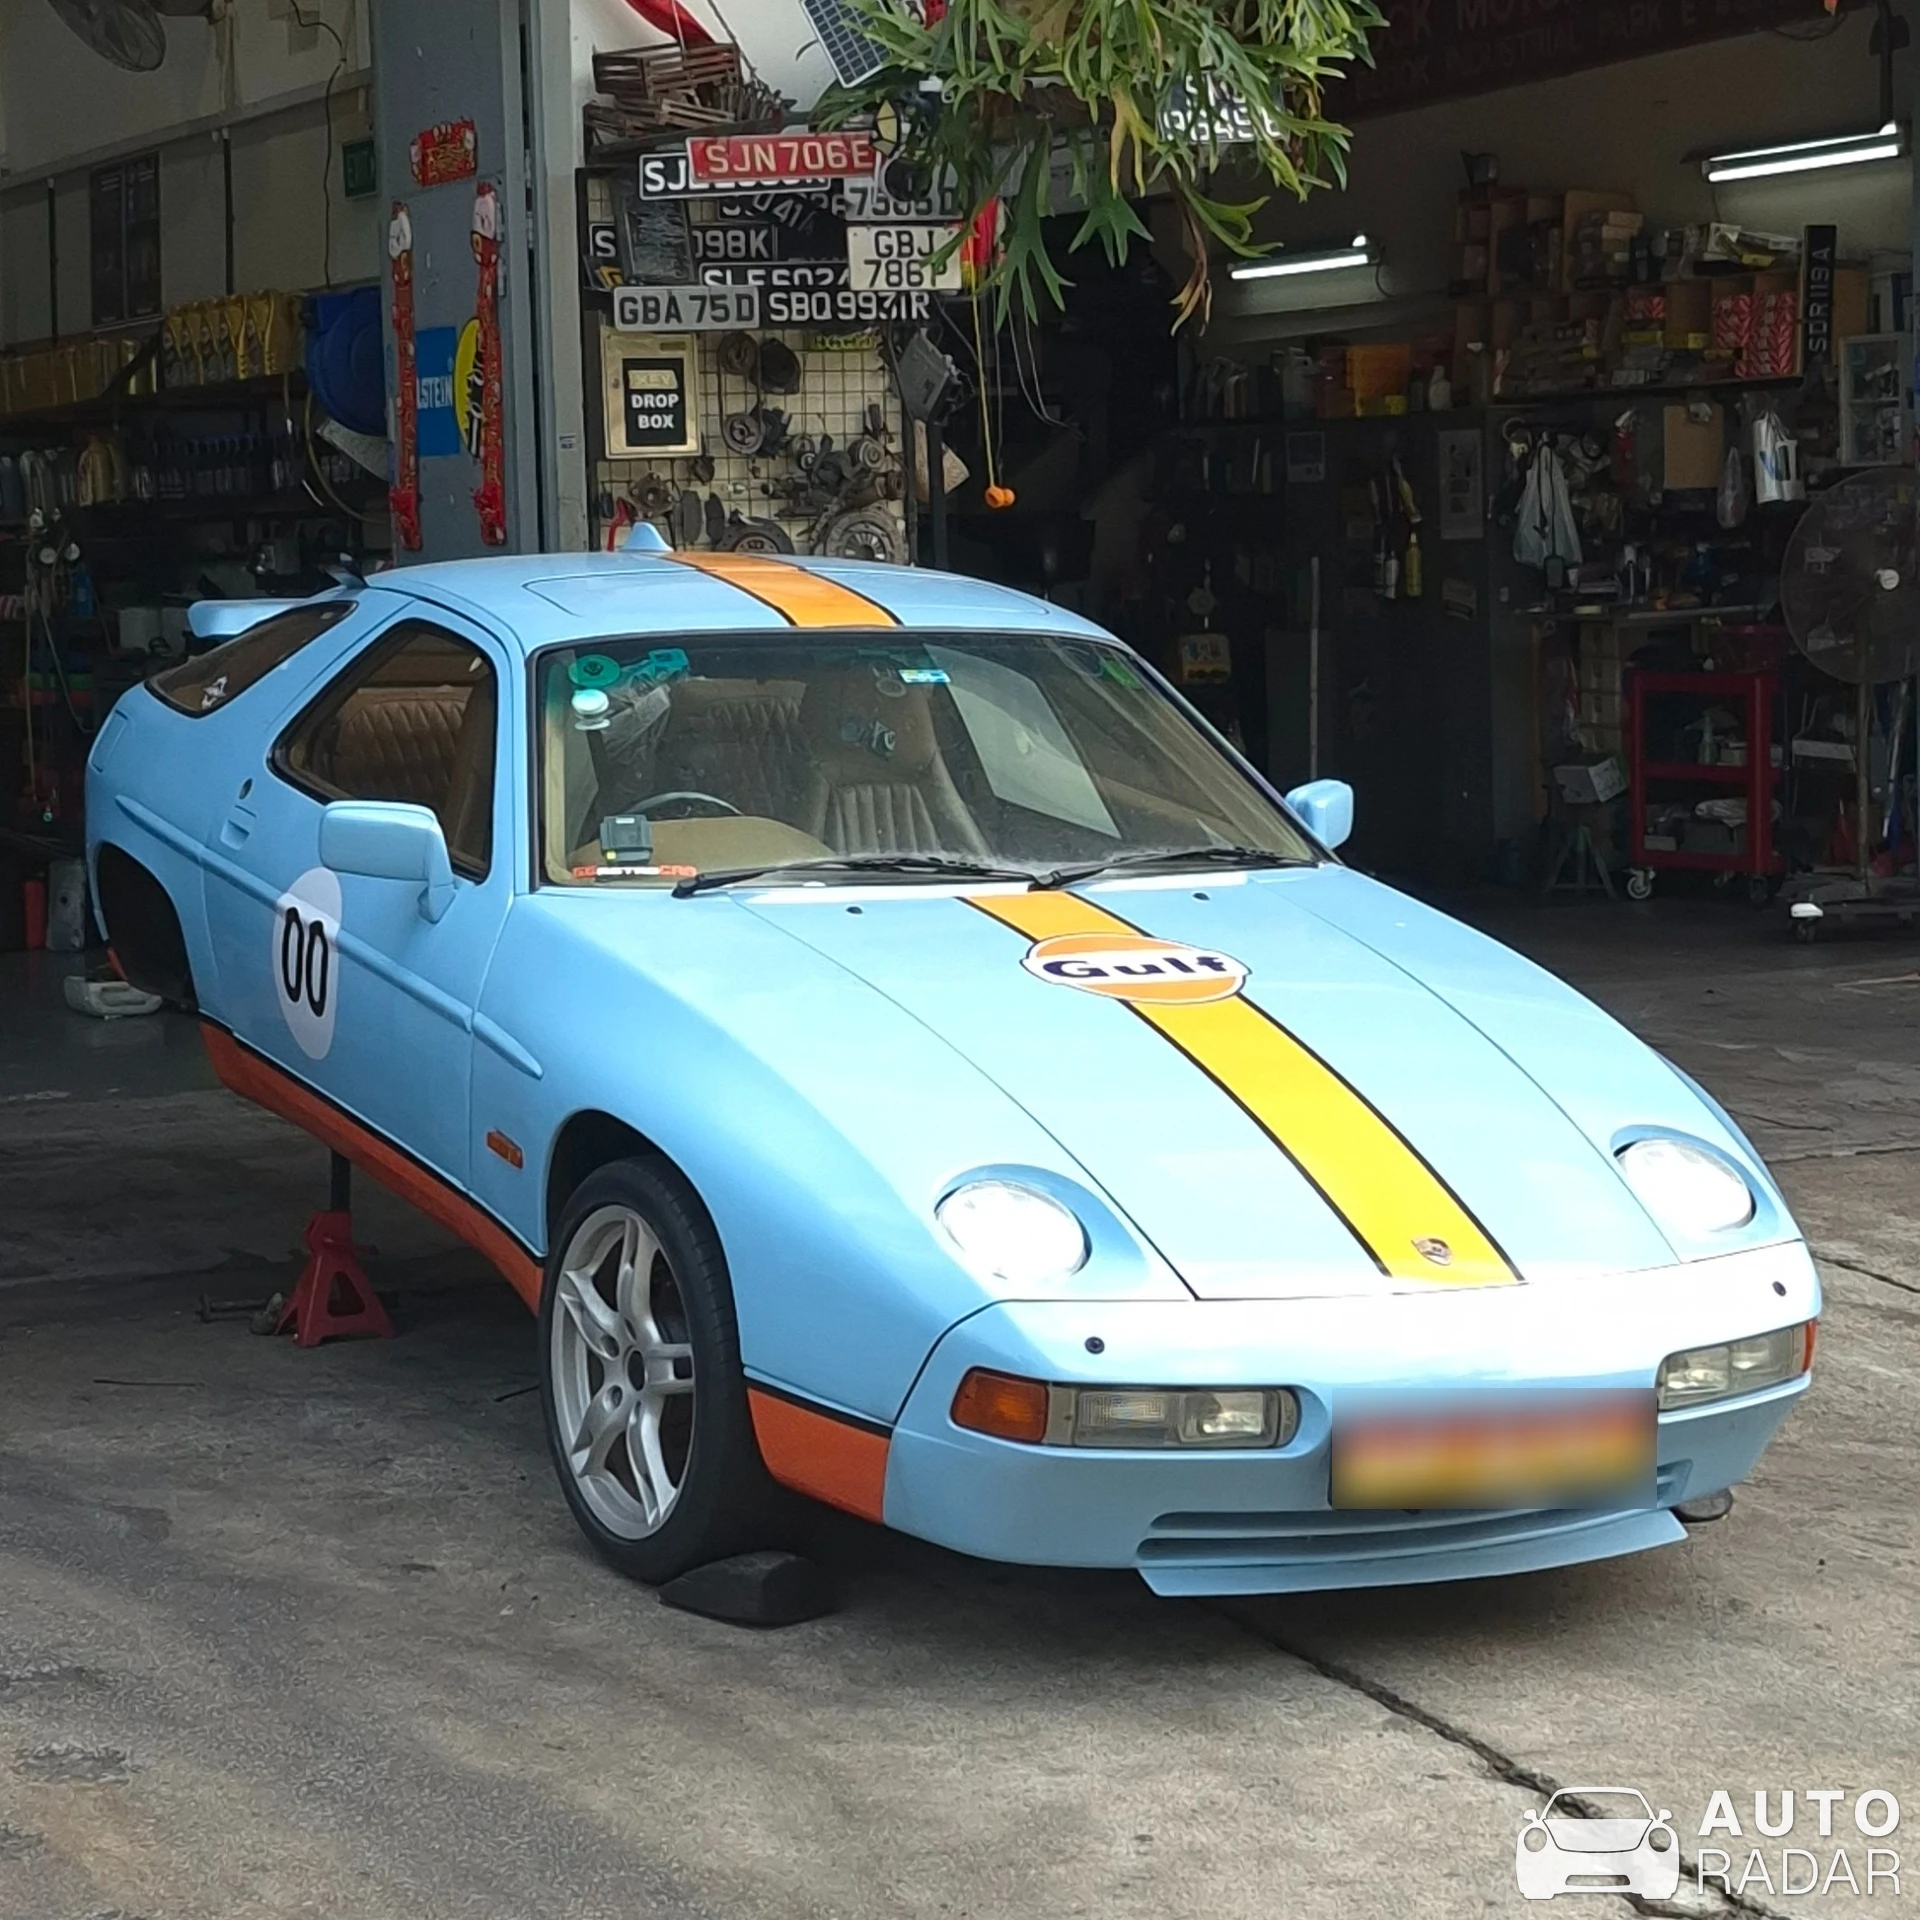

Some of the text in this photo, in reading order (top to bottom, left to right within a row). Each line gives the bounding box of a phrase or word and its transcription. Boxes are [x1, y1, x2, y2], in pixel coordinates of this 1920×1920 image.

[875, 229, 935, 259] GBJ
[863, 258, 947, 288] 786P
[630, 392, 680, 409] DROP
[637, 413, 675, 430] BOX
[281, 905, 330, 1018] 00
[1042, 955, 1228, 979] Gulf
